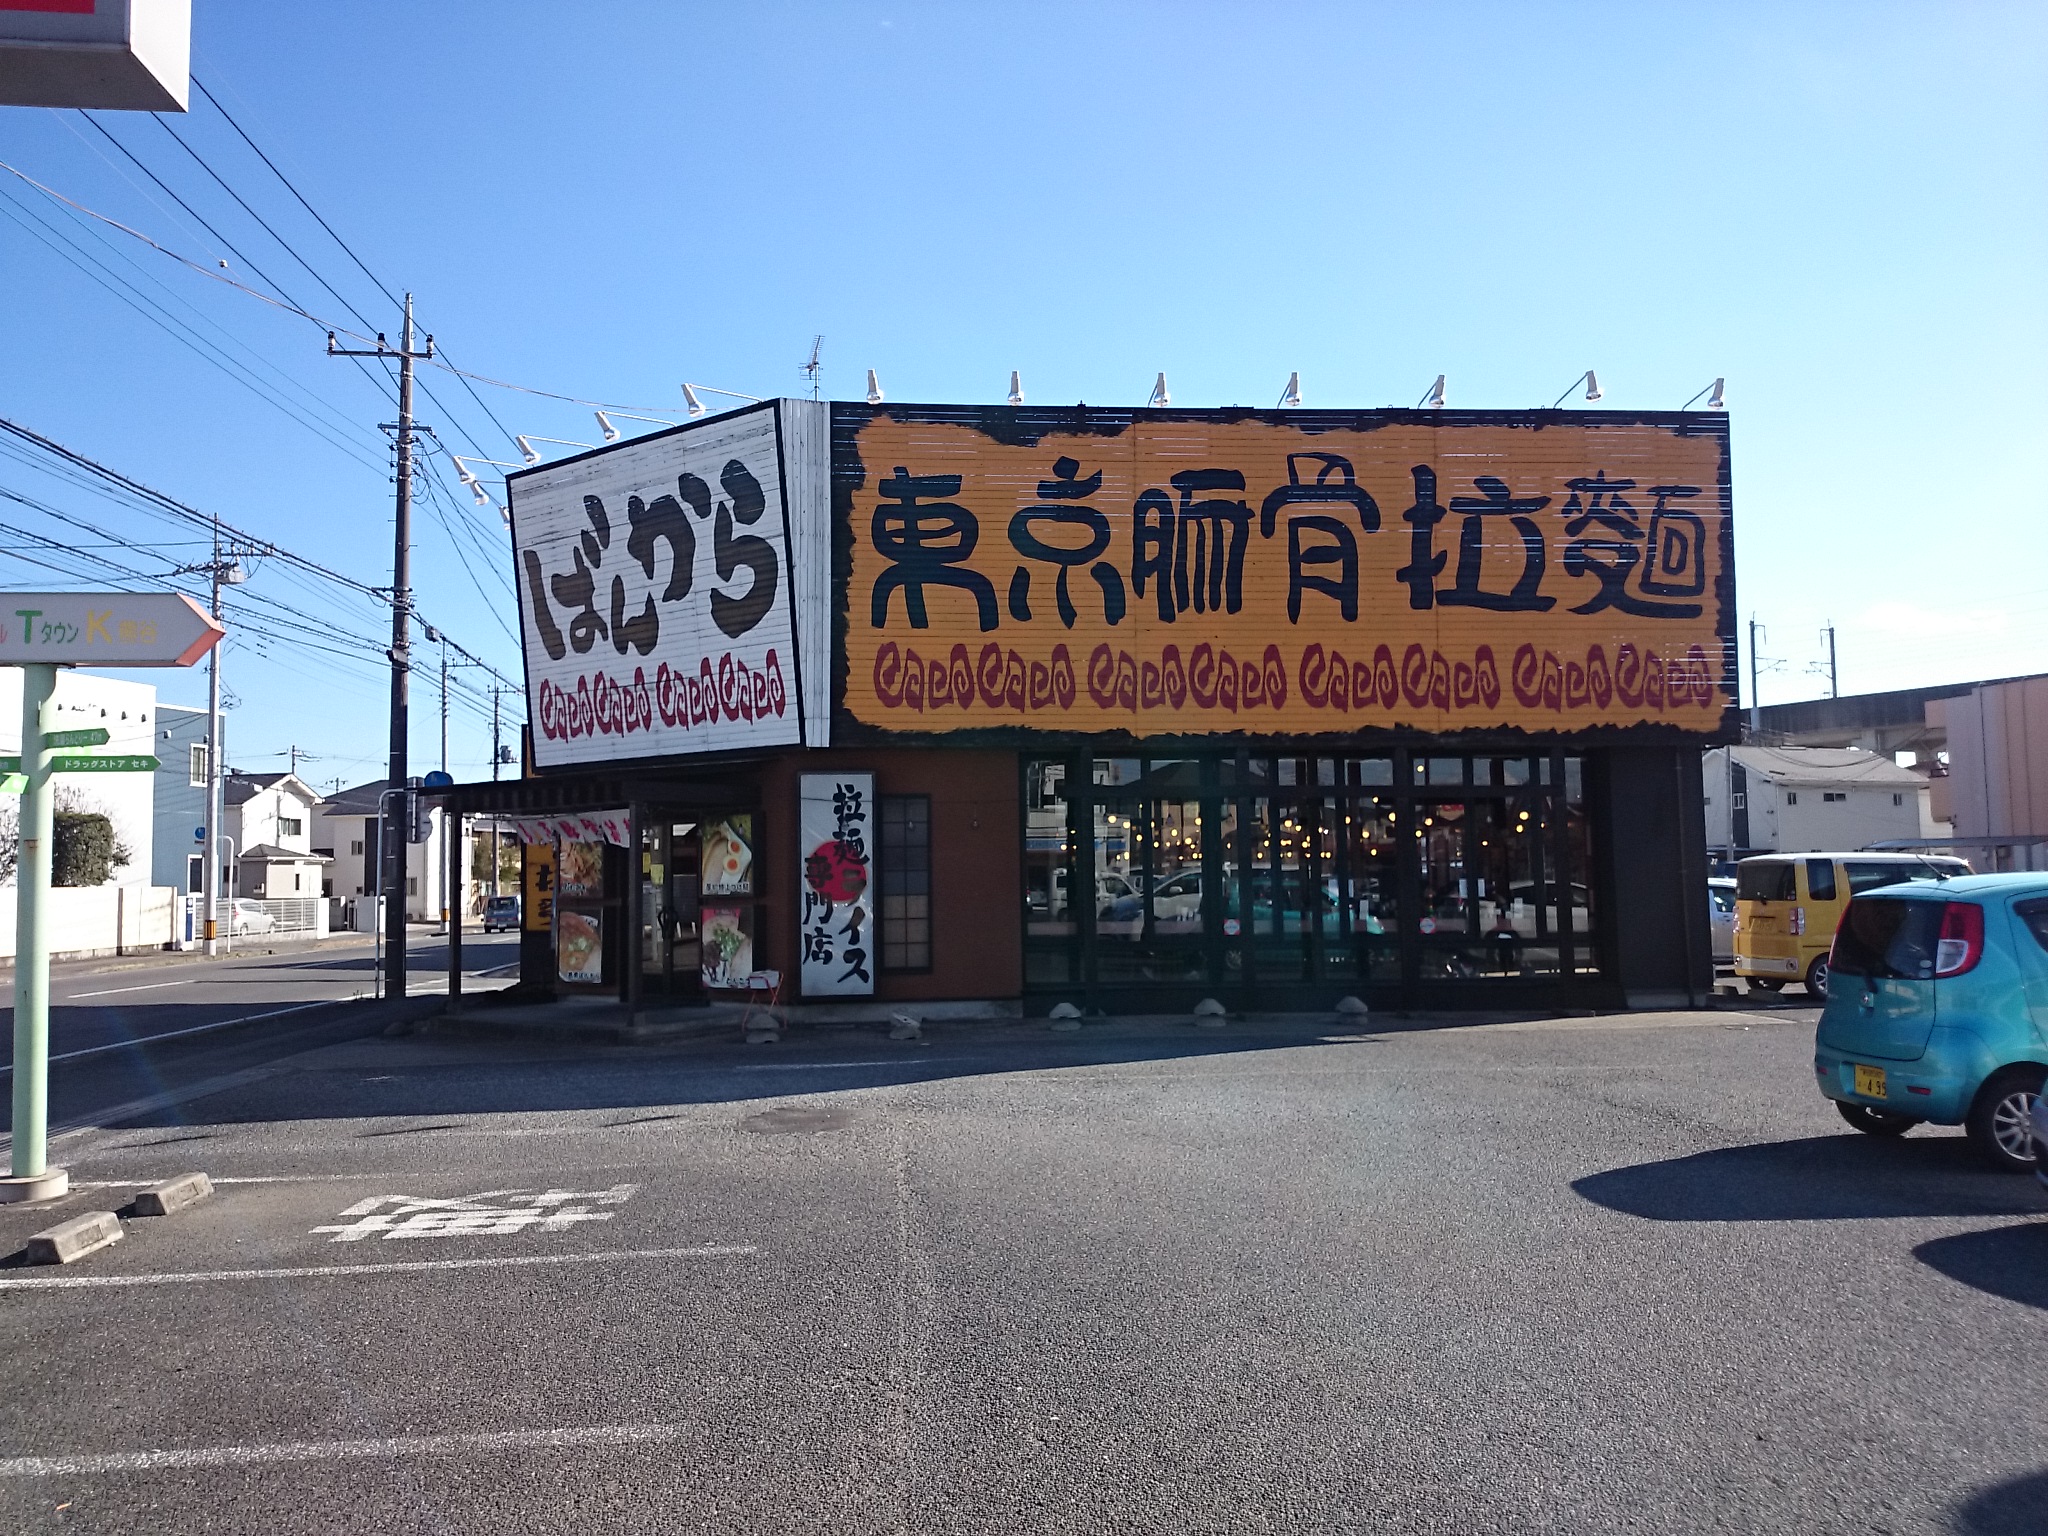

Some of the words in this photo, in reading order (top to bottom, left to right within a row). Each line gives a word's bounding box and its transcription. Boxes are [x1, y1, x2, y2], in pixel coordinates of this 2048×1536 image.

[64, 759, 126, 769] ドラッグストア
[131, 759, 149, 769] セキ
